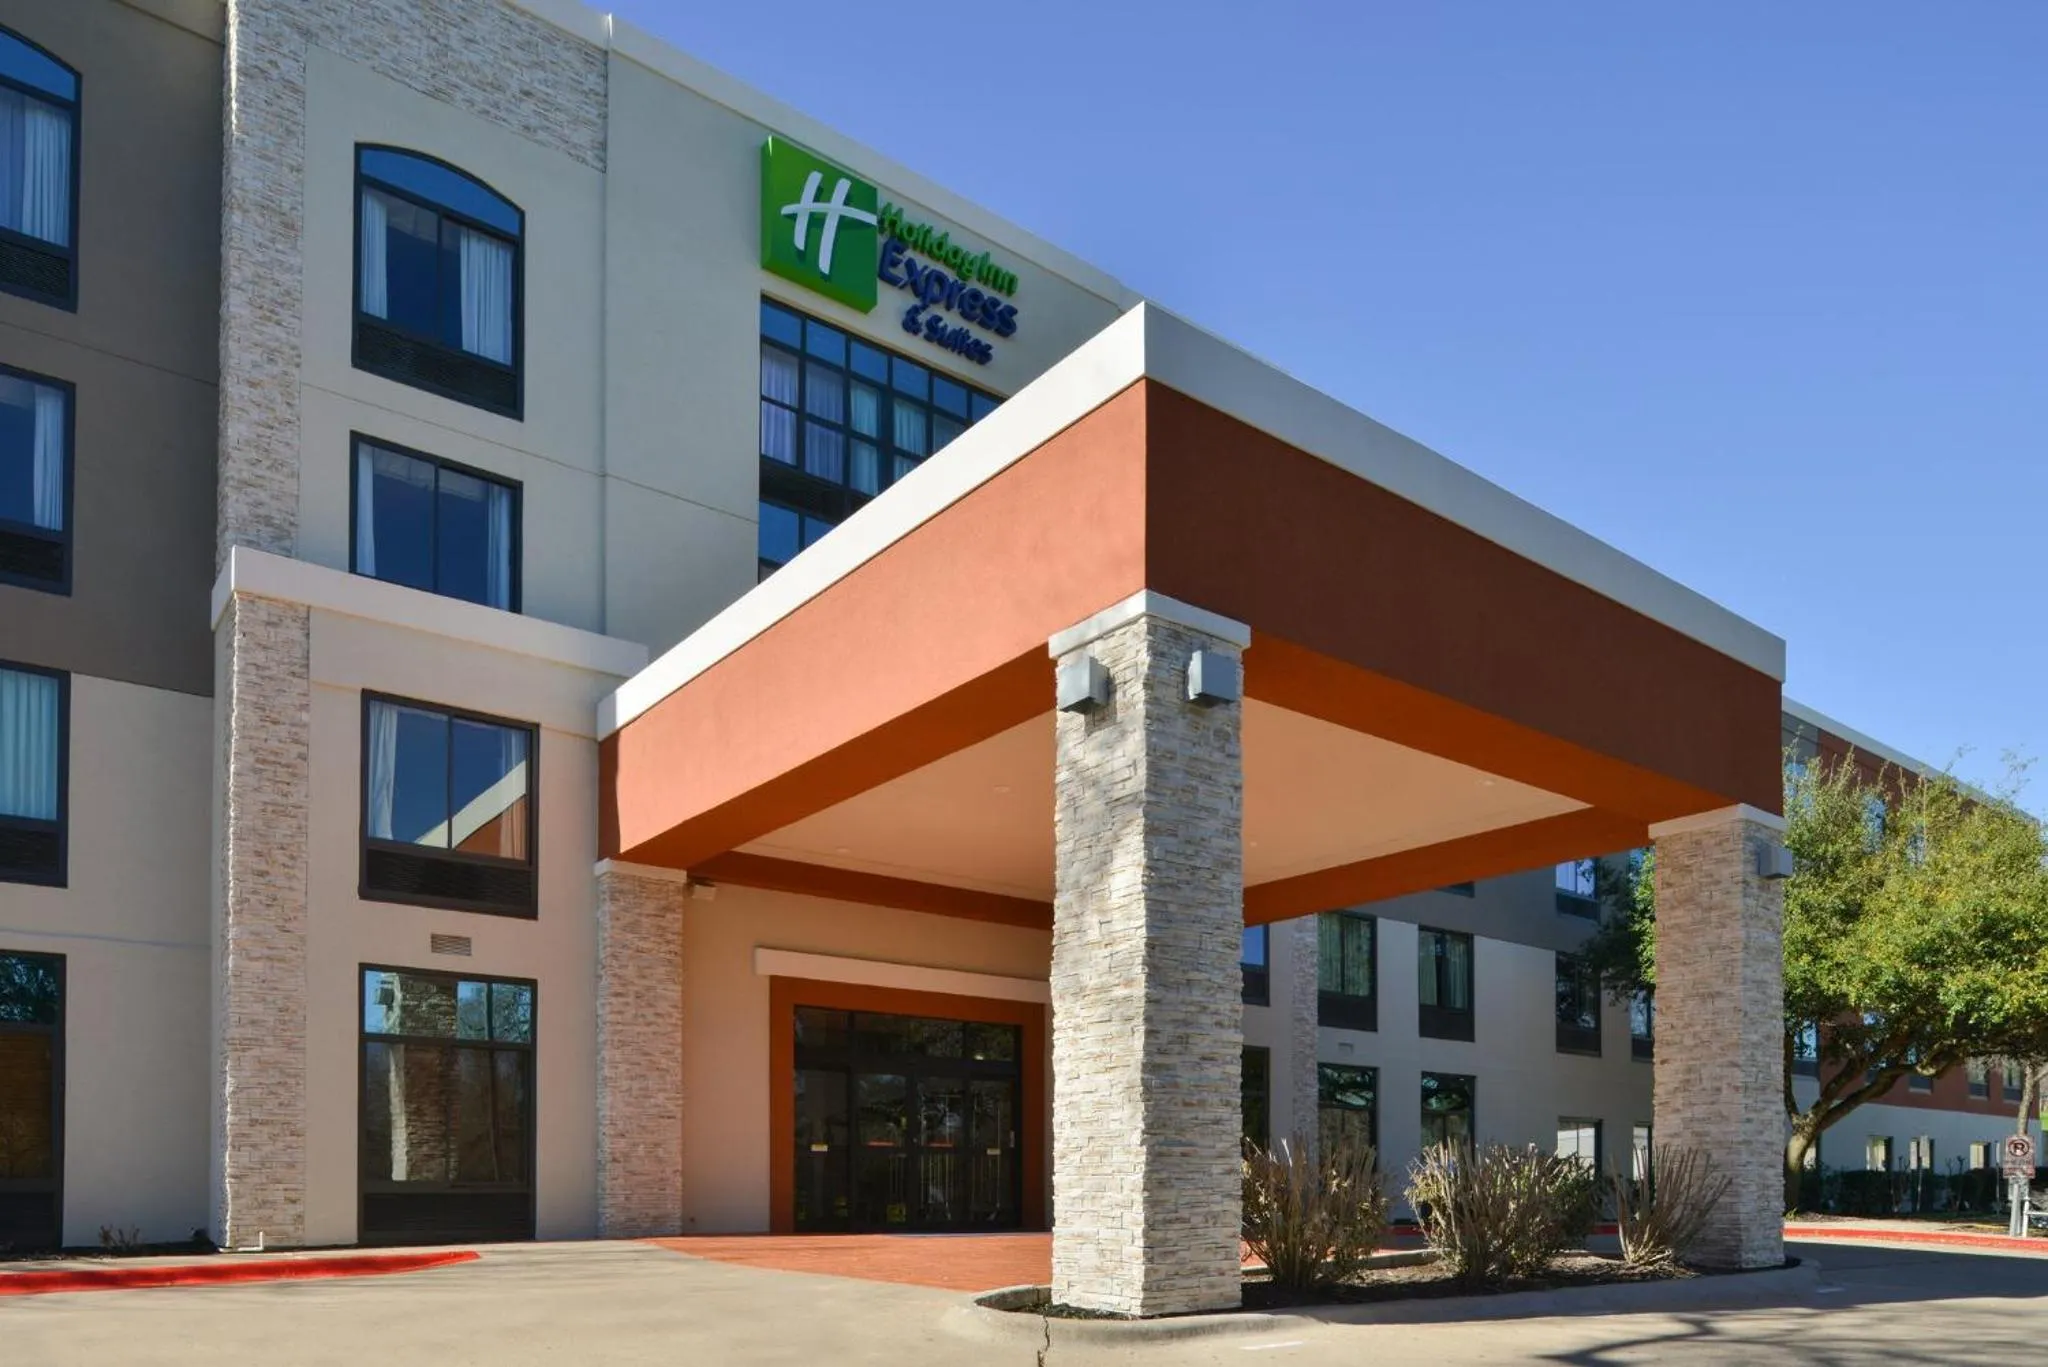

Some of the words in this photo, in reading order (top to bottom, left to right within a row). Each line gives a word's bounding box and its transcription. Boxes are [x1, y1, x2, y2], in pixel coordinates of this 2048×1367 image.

[780, 170, 878, 276] H
[878, 202, 978, 282] Holiday
[976, 251, 1019, 298] Inn
[878, 236, 1019, 338] Express
[902, 304, 923, 336] &
[924, 314, 994, 365] Suites
